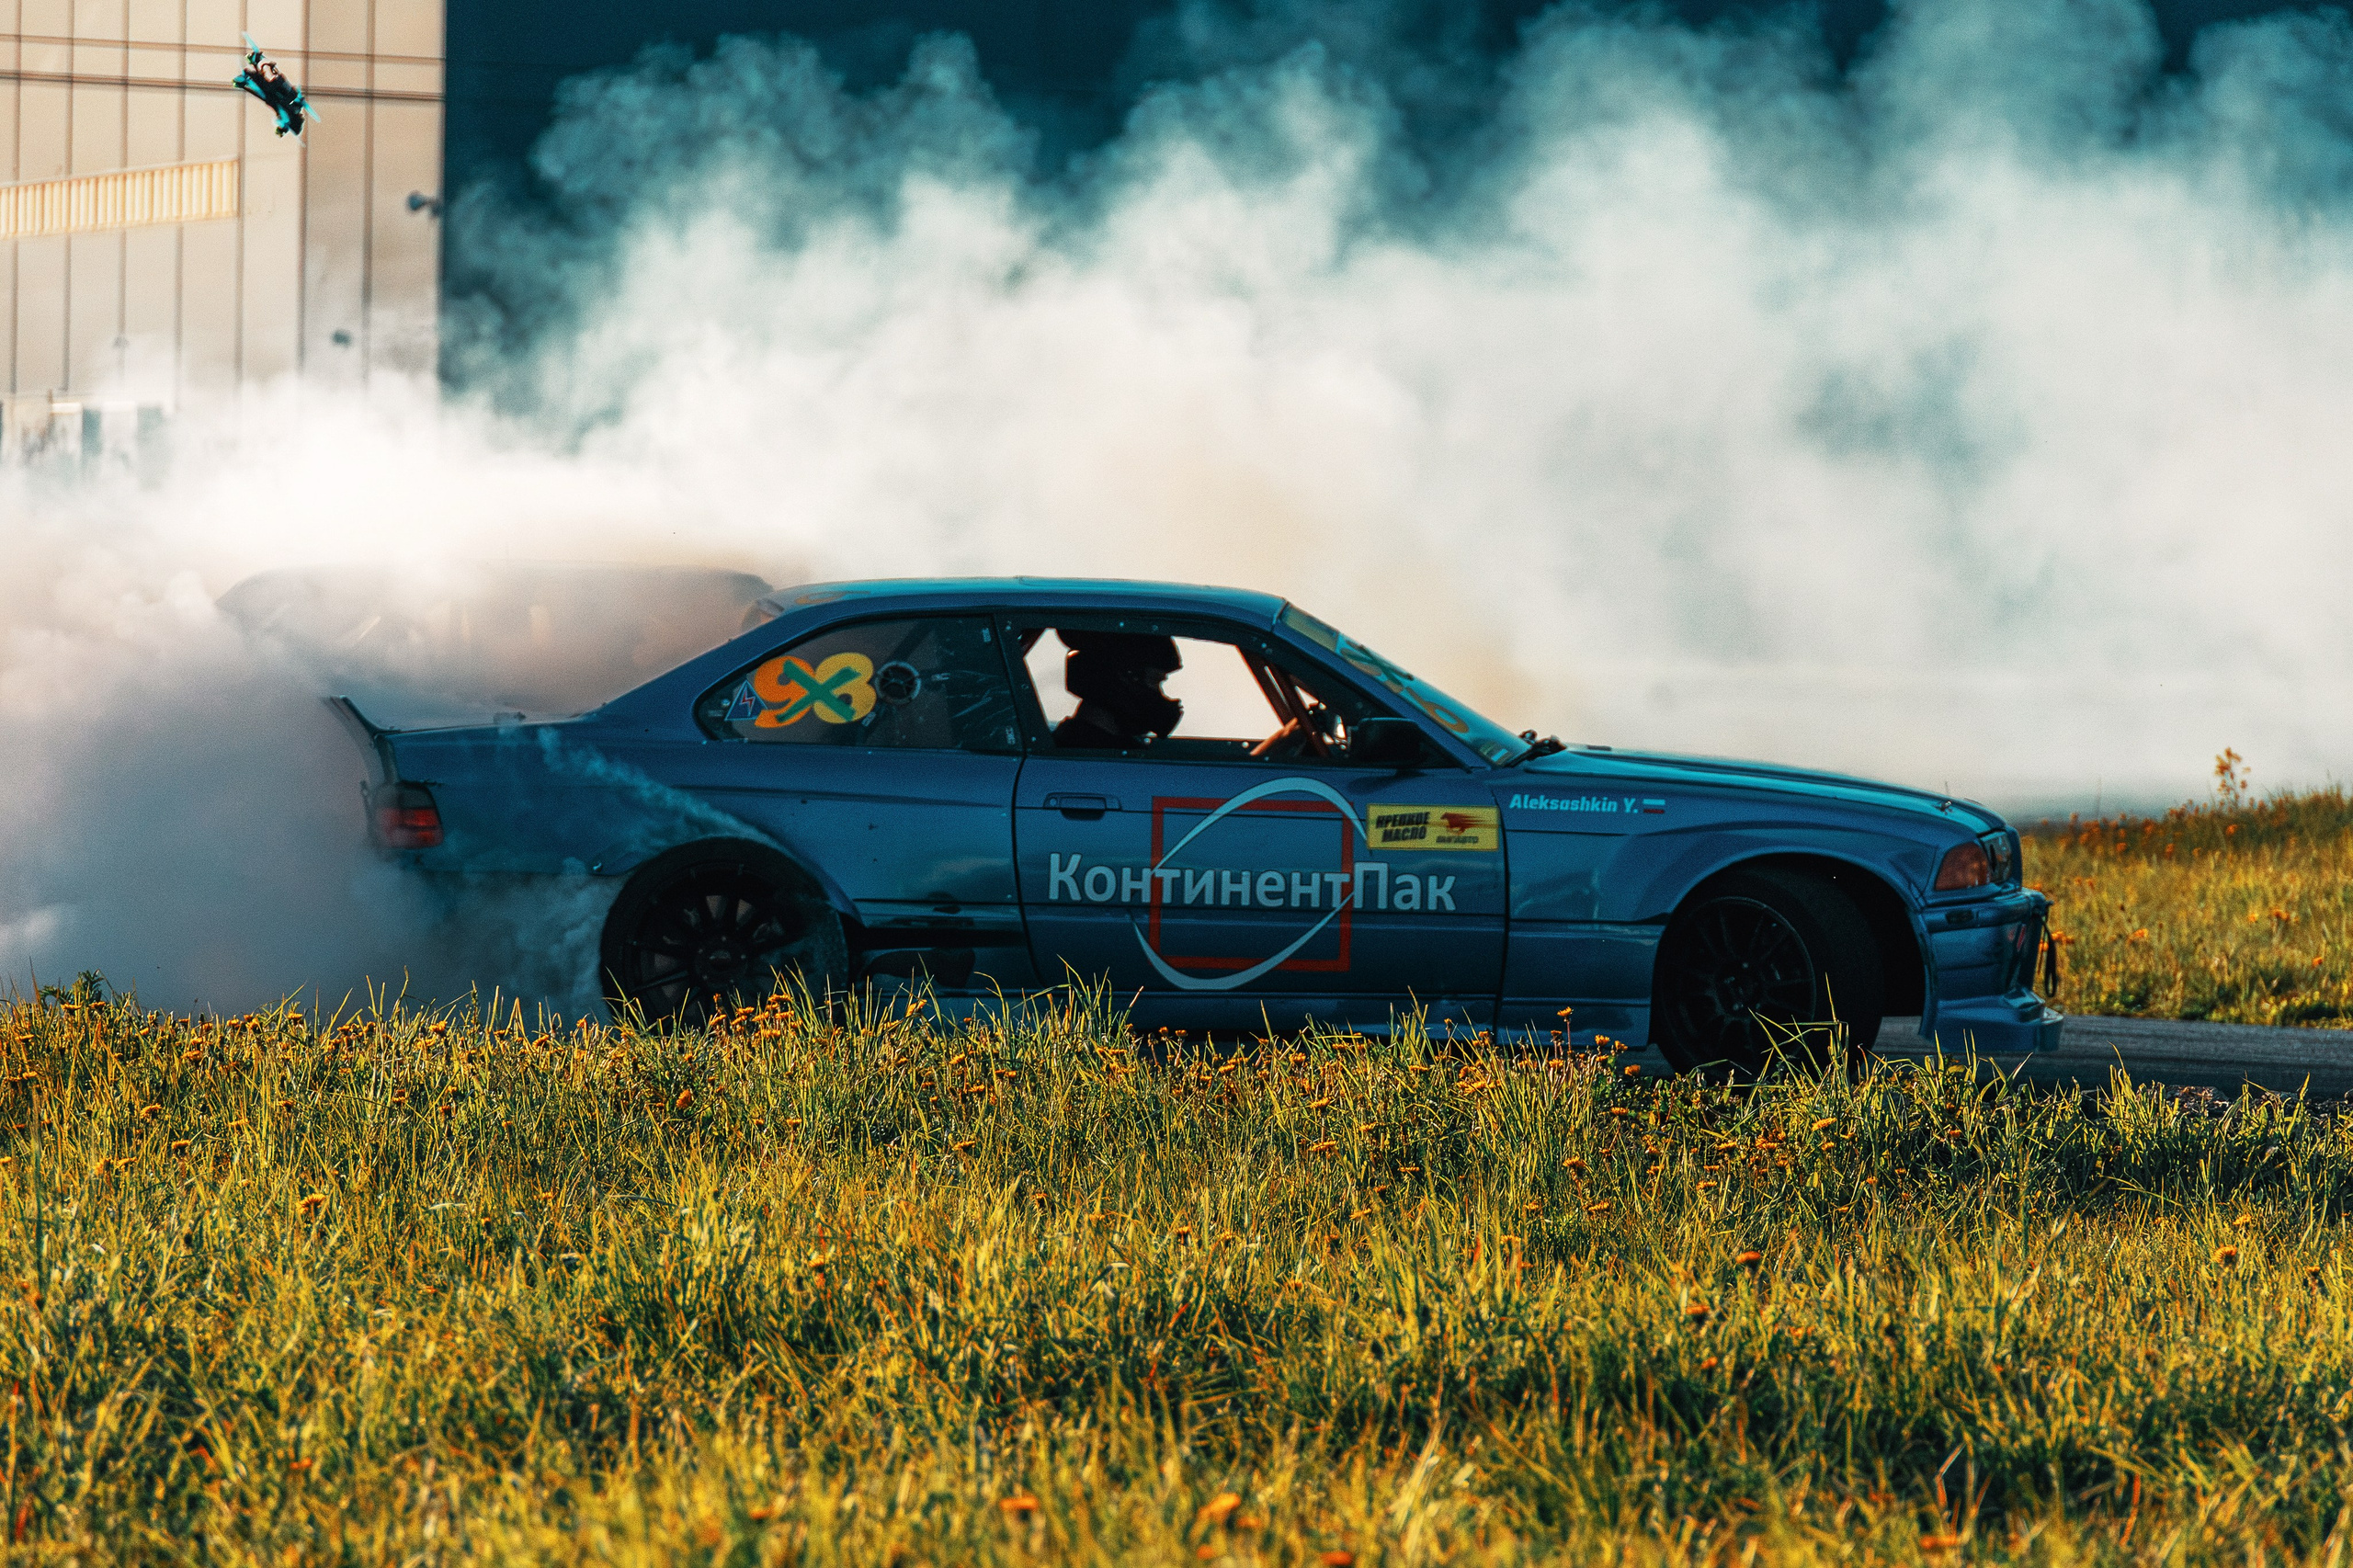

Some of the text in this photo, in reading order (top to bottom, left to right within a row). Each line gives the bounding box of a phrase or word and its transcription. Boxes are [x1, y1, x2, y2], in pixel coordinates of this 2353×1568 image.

[1509, 794, 1639, 813] Aleksashkin Y.
[1381, 826, 1427, 842] МАСЛО
[1048, 852, 1457, 912] КонтинентПак
